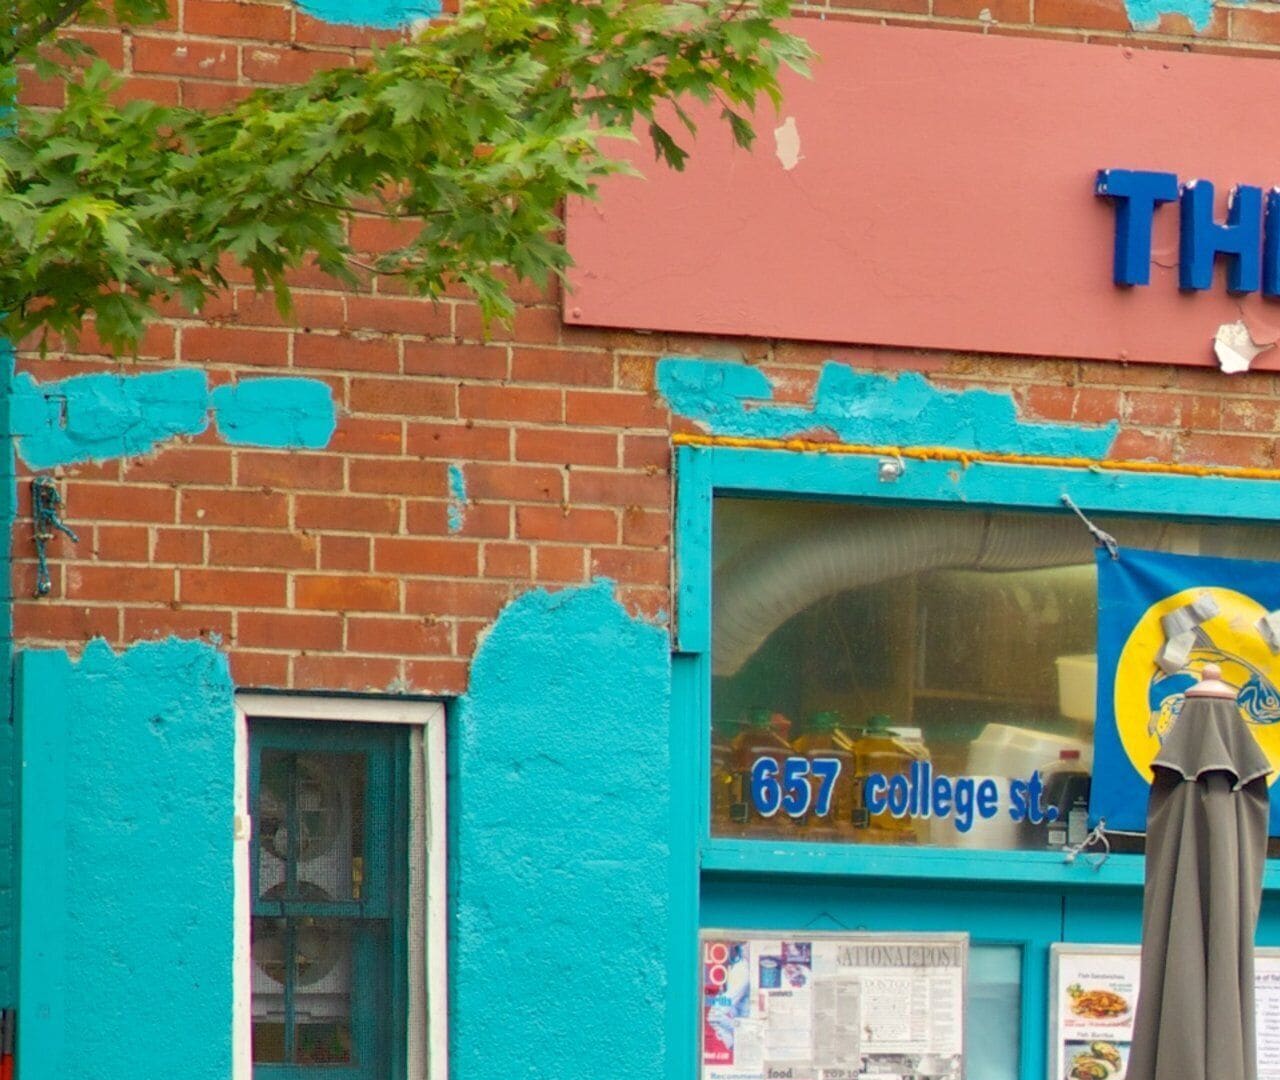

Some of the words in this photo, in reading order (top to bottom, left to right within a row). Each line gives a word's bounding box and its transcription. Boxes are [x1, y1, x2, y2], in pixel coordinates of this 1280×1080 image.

[751, 757, 842, 818] 657
[864, 760, 999, 833] college
[1008, 770, 1060, 824] st.
